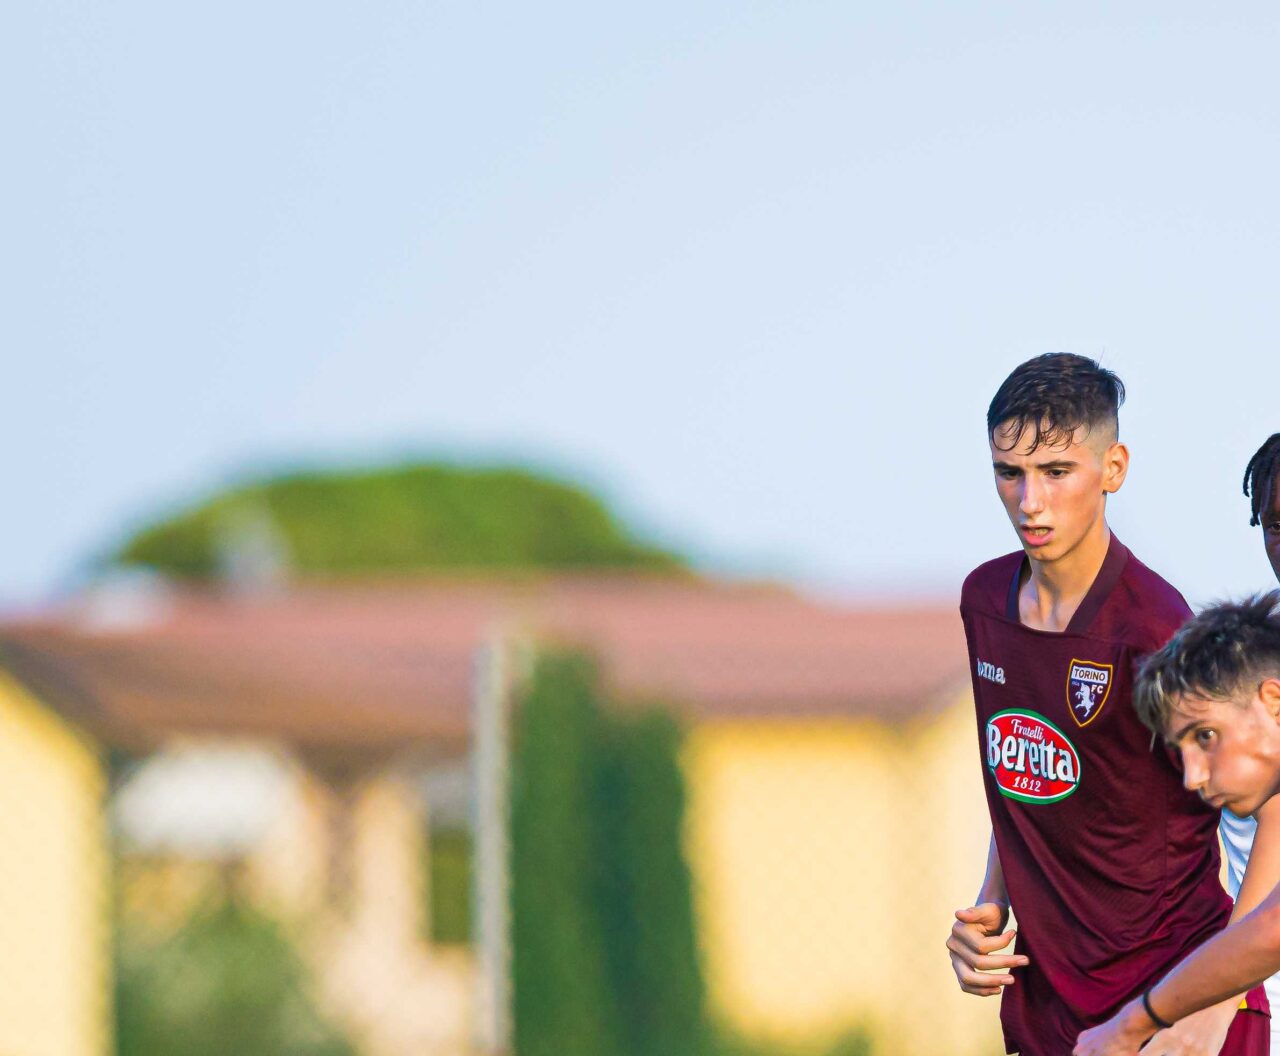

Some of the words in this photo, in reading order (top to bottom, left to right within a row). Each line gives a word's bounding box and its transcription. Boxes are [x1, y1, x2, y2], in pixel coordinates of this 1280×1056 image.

[977, 658, 1005, 685] oma
[1074, 668, 1106, 682] TORINO
[1091, 684, 1104, 694] FC
[1011, 718, 1045, 741] Fratelli
[986, 722, 1076, 783] Beretta
[1012, 776, 1041, 793] 1812
